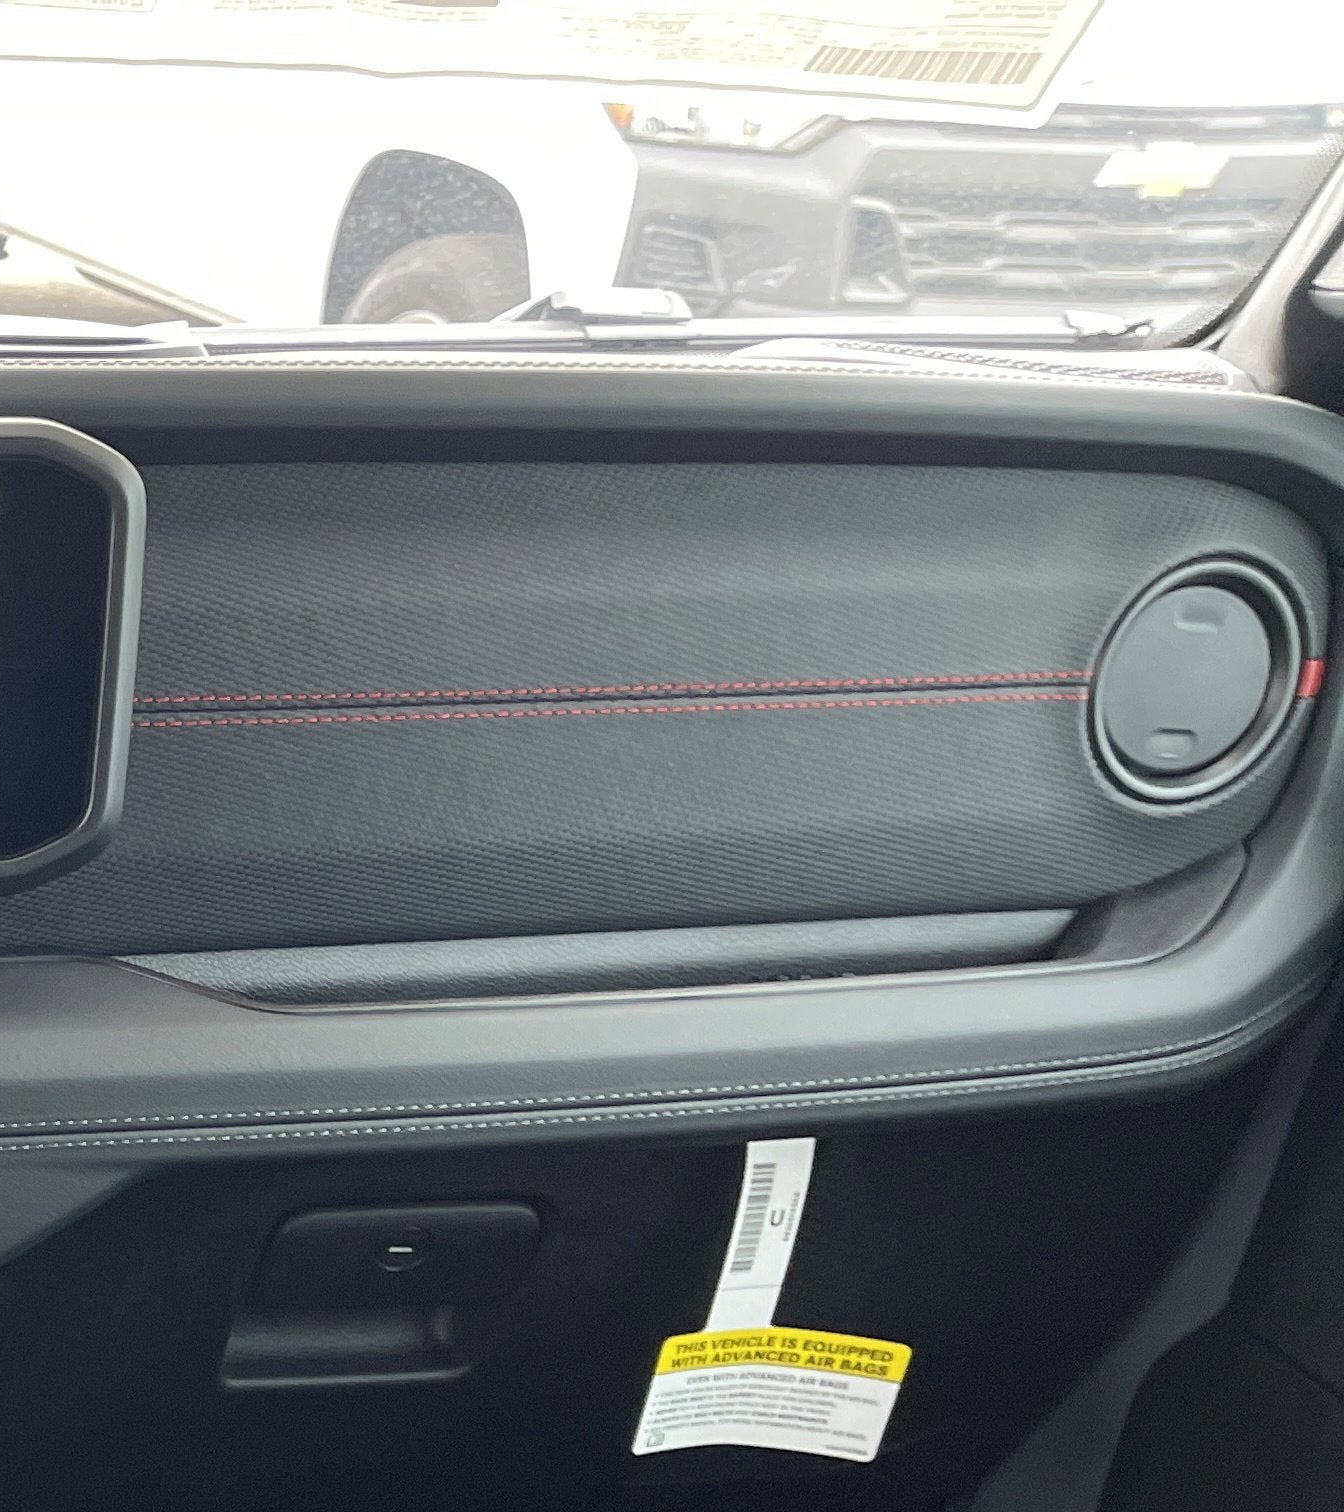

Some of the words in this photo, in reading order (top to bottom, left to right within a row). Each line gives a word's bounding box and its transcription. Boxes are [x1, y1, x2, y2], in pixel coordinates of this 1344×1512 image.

[676, 1341, 708, 1354] THIS
[712, 1336, 776, 1349] VEHICLE
[781, 1337, 798, 1348] IS
[802, 1340, 894, 1362] EQUIPPED
[671, 1354, 707, 1368] WITH
[712, 1351, 799, 1363] ADVANCED
[804, 1357, 836, 1369] AIR
[840, 1361, 890, 1376] BAGS
